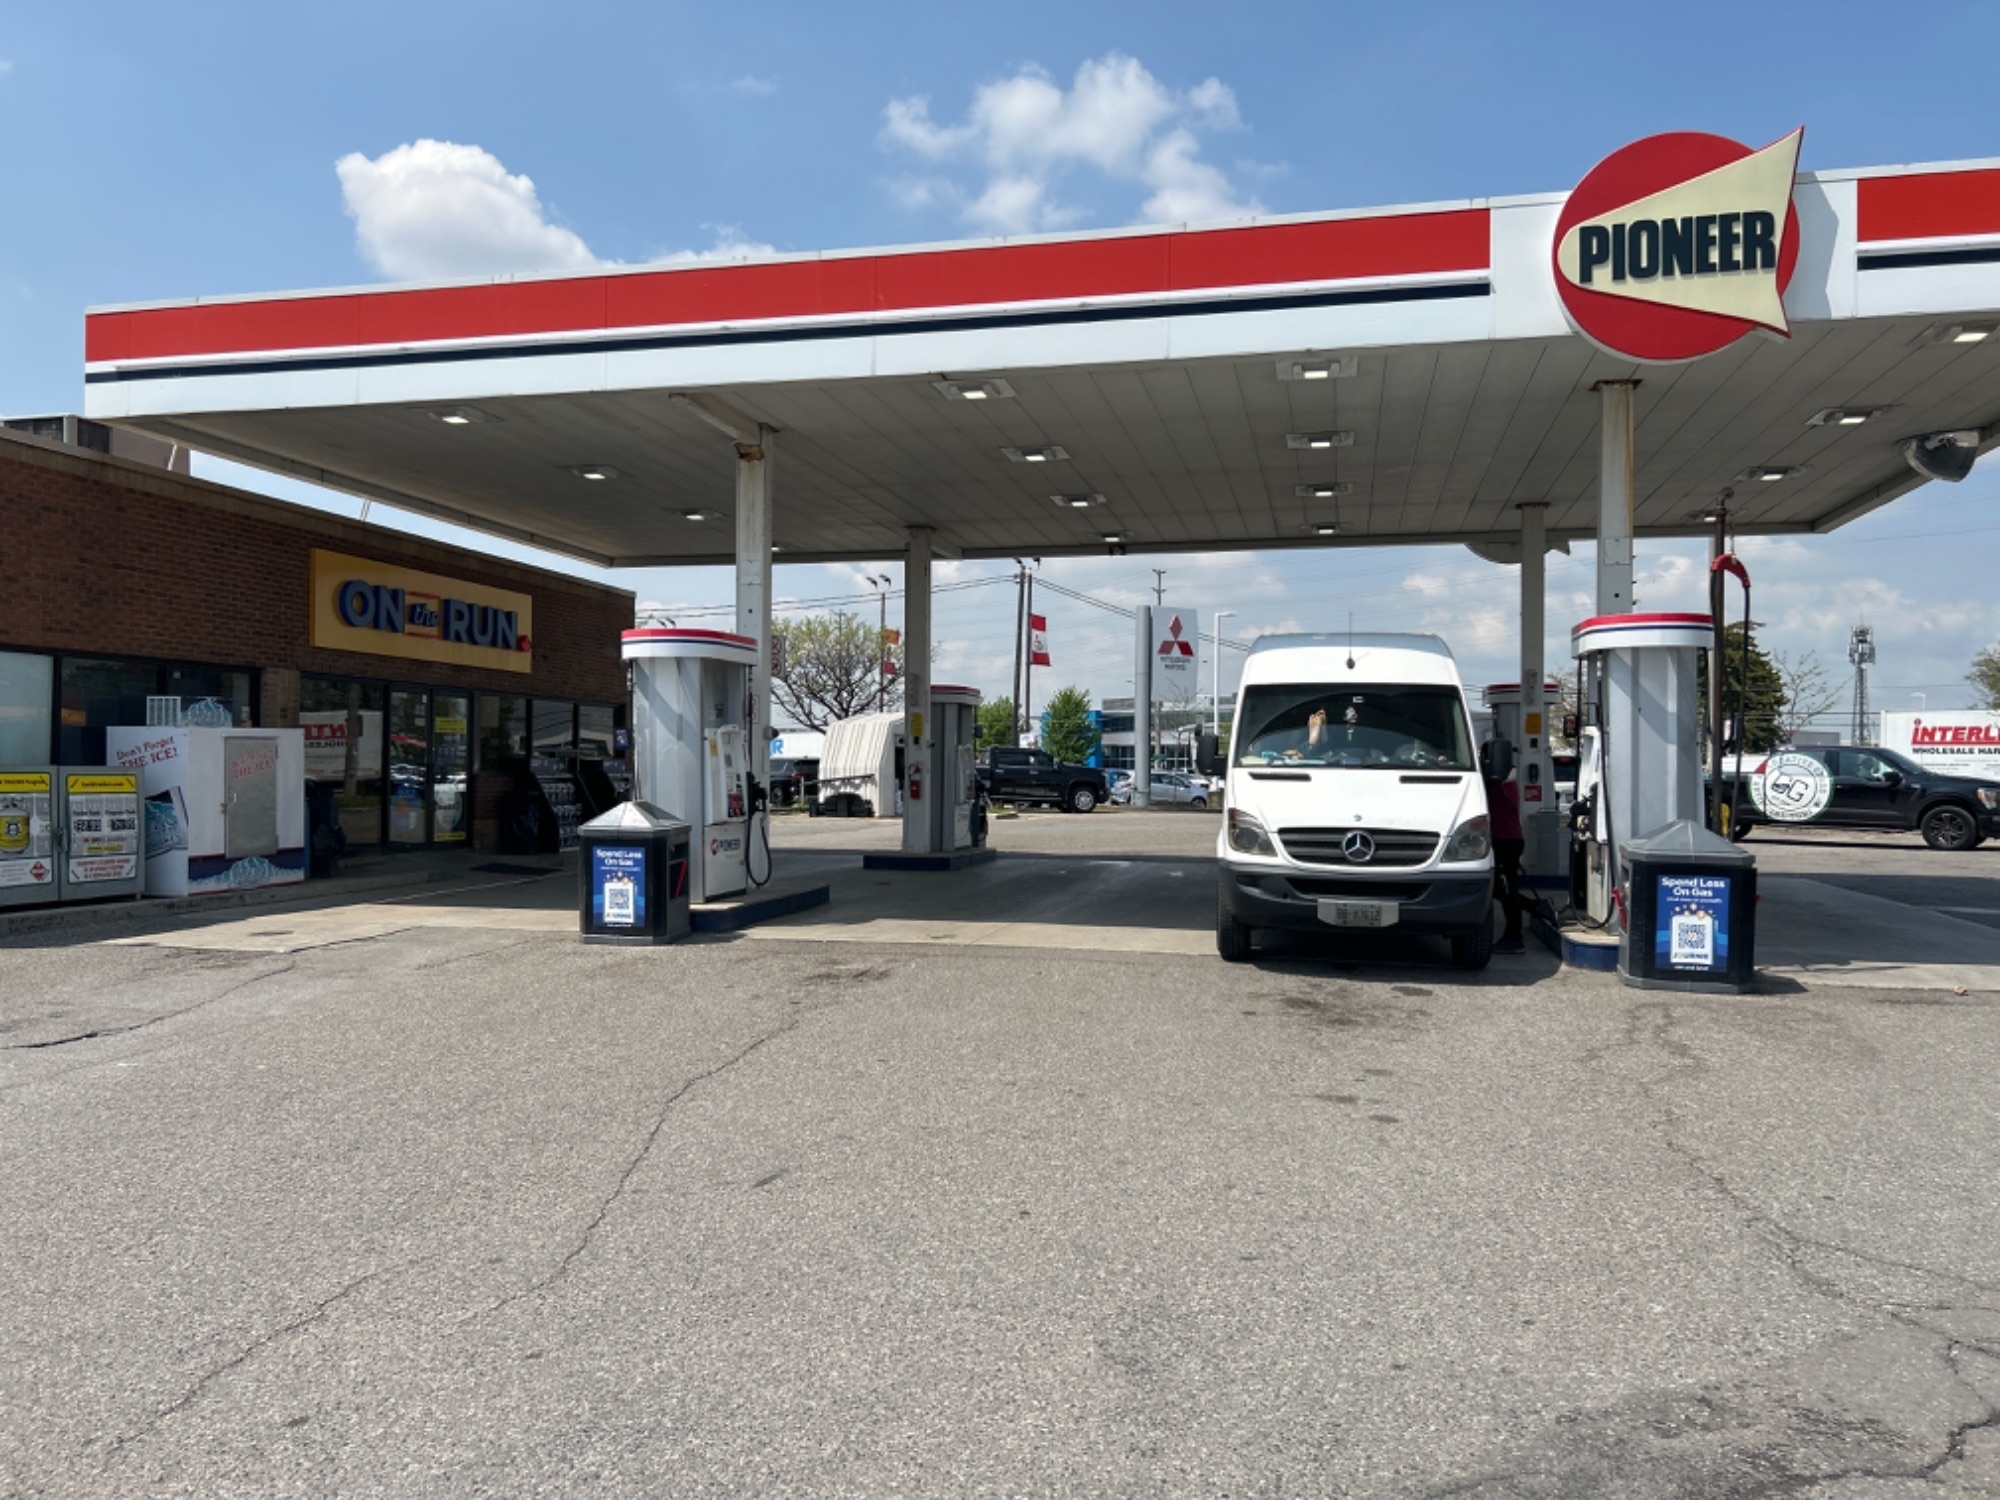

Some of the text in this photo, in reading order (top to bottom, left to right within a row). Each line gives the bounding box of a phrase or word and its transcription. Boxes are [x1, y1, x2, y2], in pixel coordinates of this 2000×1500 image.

[1579, 210, 1776, 284] PIONEER
[338, 580, 517, 650] ON the RUN
[116, 735, 174, 760] Don't Forget
[119, 746, 178, 767] THE ICE!
[1912, 747, 1975, 755] WHOLESALE
[1662, 877, 1725, 888] Spend Less
[1673, 887, 1713, 897] On Gas
